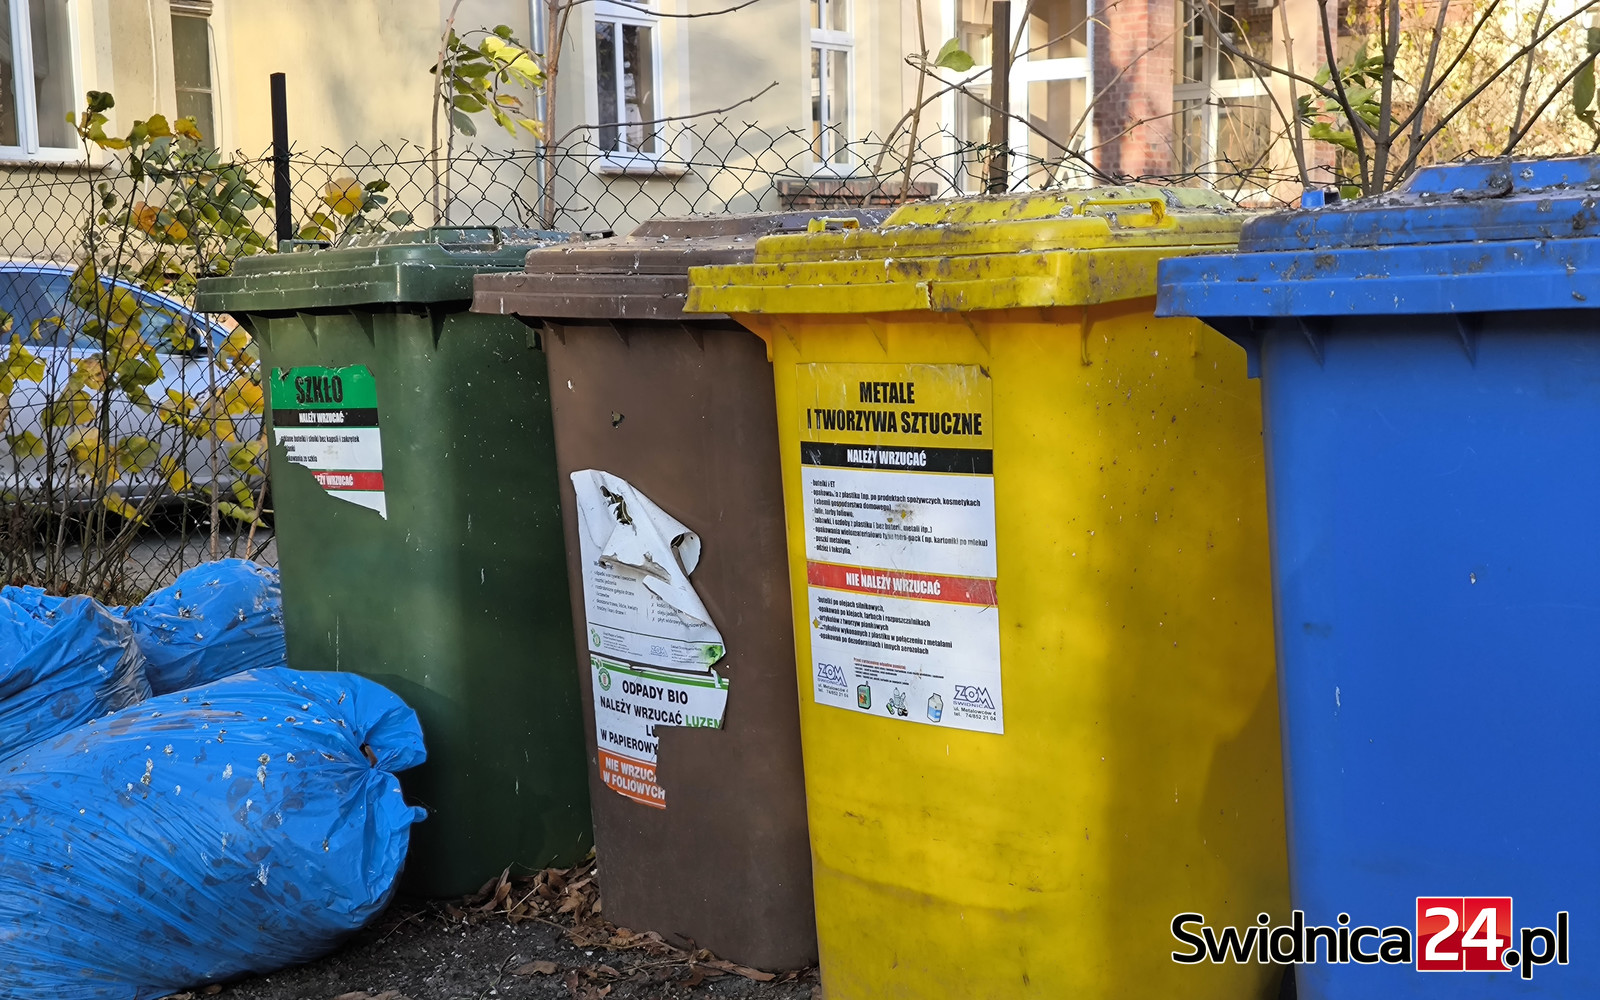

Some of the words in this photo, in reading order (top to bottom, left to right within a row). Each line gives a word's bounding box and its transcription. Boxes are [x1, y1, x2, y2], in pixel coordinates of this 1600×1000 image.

[295, 375, 344, 403] SZKŁO
[859, 381, 915, 404] METALE
[299, 411, 317, 423] NALEŻY
[317, 410, 345, 423] WRZUCAĆ
[807, 408, 812, 429] I
[814, 408, 898, 433] TWORZYWA
[901, 411, 982, 436] SZTUCZNE
[847, 448, 877, 464] NALEŻY
[878, 450, 927, 467] WRZUCAĆ
[326, 473, 354, 486] WRZUCAĆ
[831, 499, 862, 509] gospodarstwa
[842, 490, 860, 499] plastiku
[870, 493, 877, 501] po
[877, 493, 906, 502] produktach
[943, 498, 980, 507] kosmetykach
[825, 508, 836, 517] torby
[835, 517, 850, 527] ozdoby
[853, 519, 872, 529] plastiku
[934, 536, 959, 545] kartoniki
[960, 538, 967, 546] po
[846, 572, 860, 587] NIE
[861, 573, 891, 590] NALEŻY
[892, 577, 941, 596] WRZUCAĆ
[839, 599, 855, 608] olejach
[864, 612, 882, 621] farbach
[843, 618, 860, 628] tworzyw
[861, 620, 889, 631] piankowych
[841, 626, 868, 638] wykonanych
[871, 630, 890, 640] plastiku
[895, 635, 923, 645] połączeniu
[927, 638, 953, 648] metalami
[848, 637, 880, 648] dezodorantach
[884, 642, 900, 652] innych
[817, 662, 848, 687] ZOM
[622, 680, 664, 701] ODPADY
[667, 690, 688, 705] BIO
[953, 684, 995, 710] ZOM
[600, 695, 631, 715] NALEŻY
[634, 705, 683, 725] WRZUCAĆ
[960, 707, 992, 716] Metalowców
[601, 729, 608, 741] W
[605, 757, 619, 772] NIE
[603, 770, 610, 784] W
[612, 774, 665, 800] FOLIOWYCH
